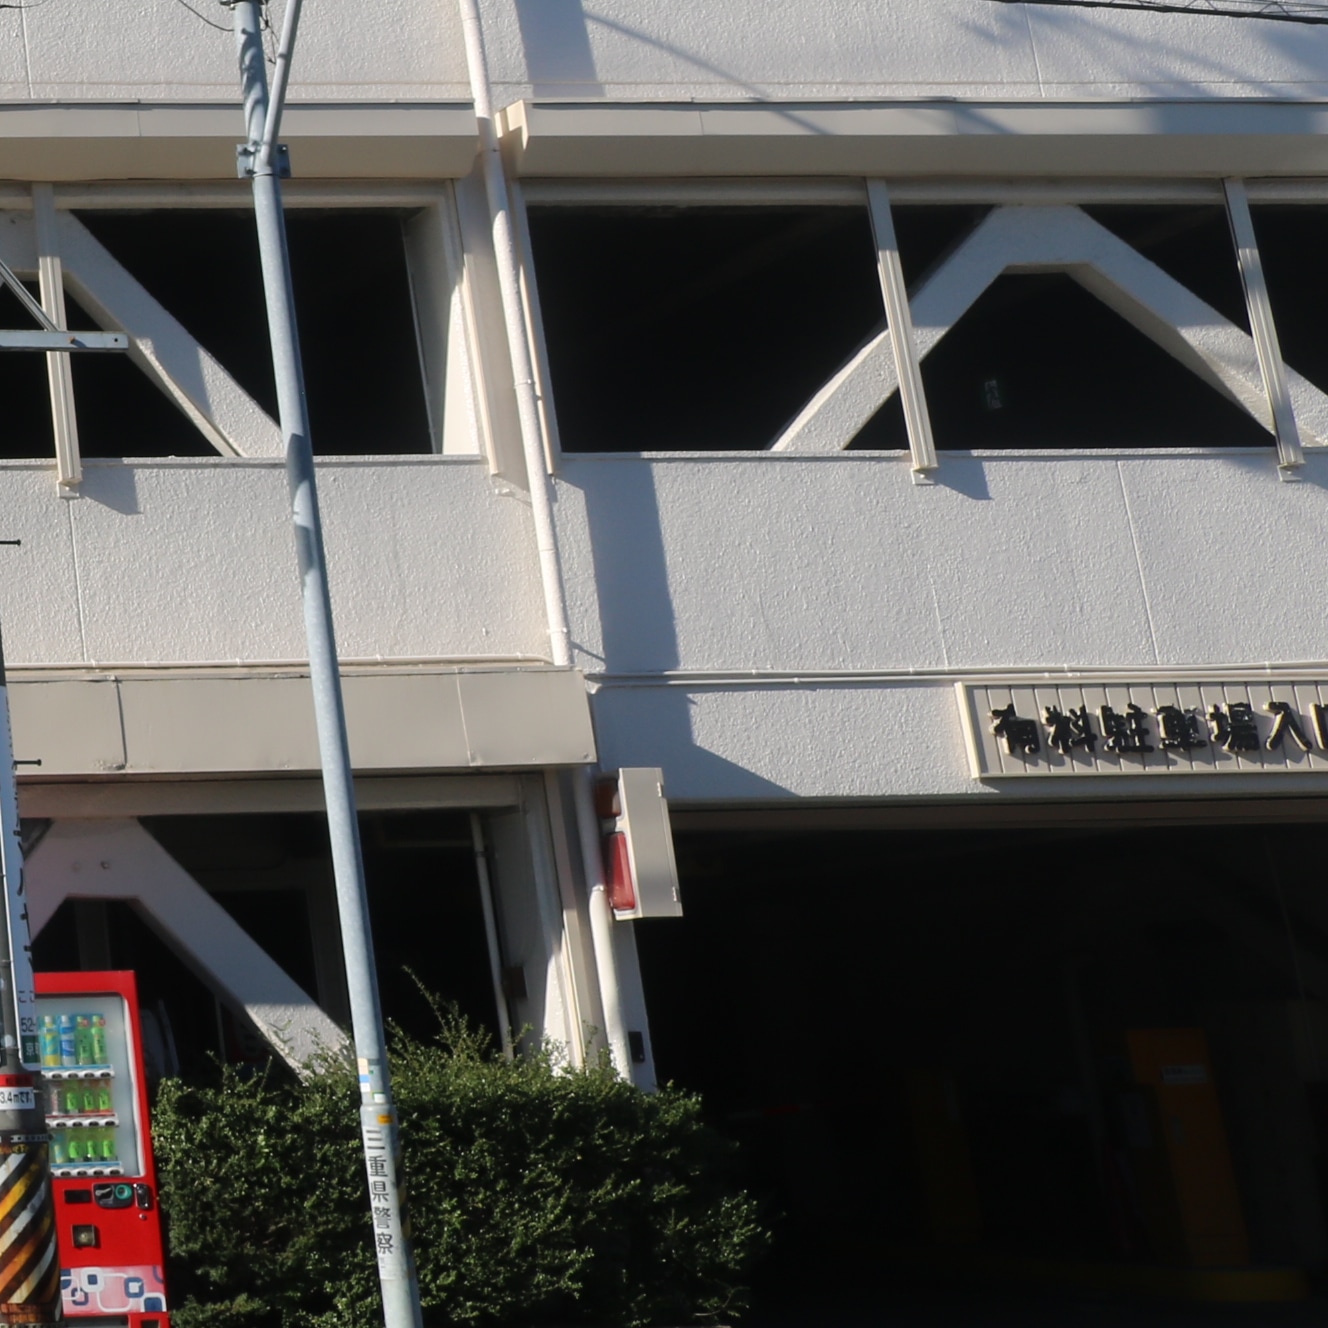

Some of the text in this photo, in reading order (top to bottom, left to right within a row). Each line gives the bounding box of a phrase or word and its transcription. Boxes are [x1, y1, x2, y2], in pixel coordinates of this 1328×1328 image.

[365, 1129, 393, 1255] 三重県警察
